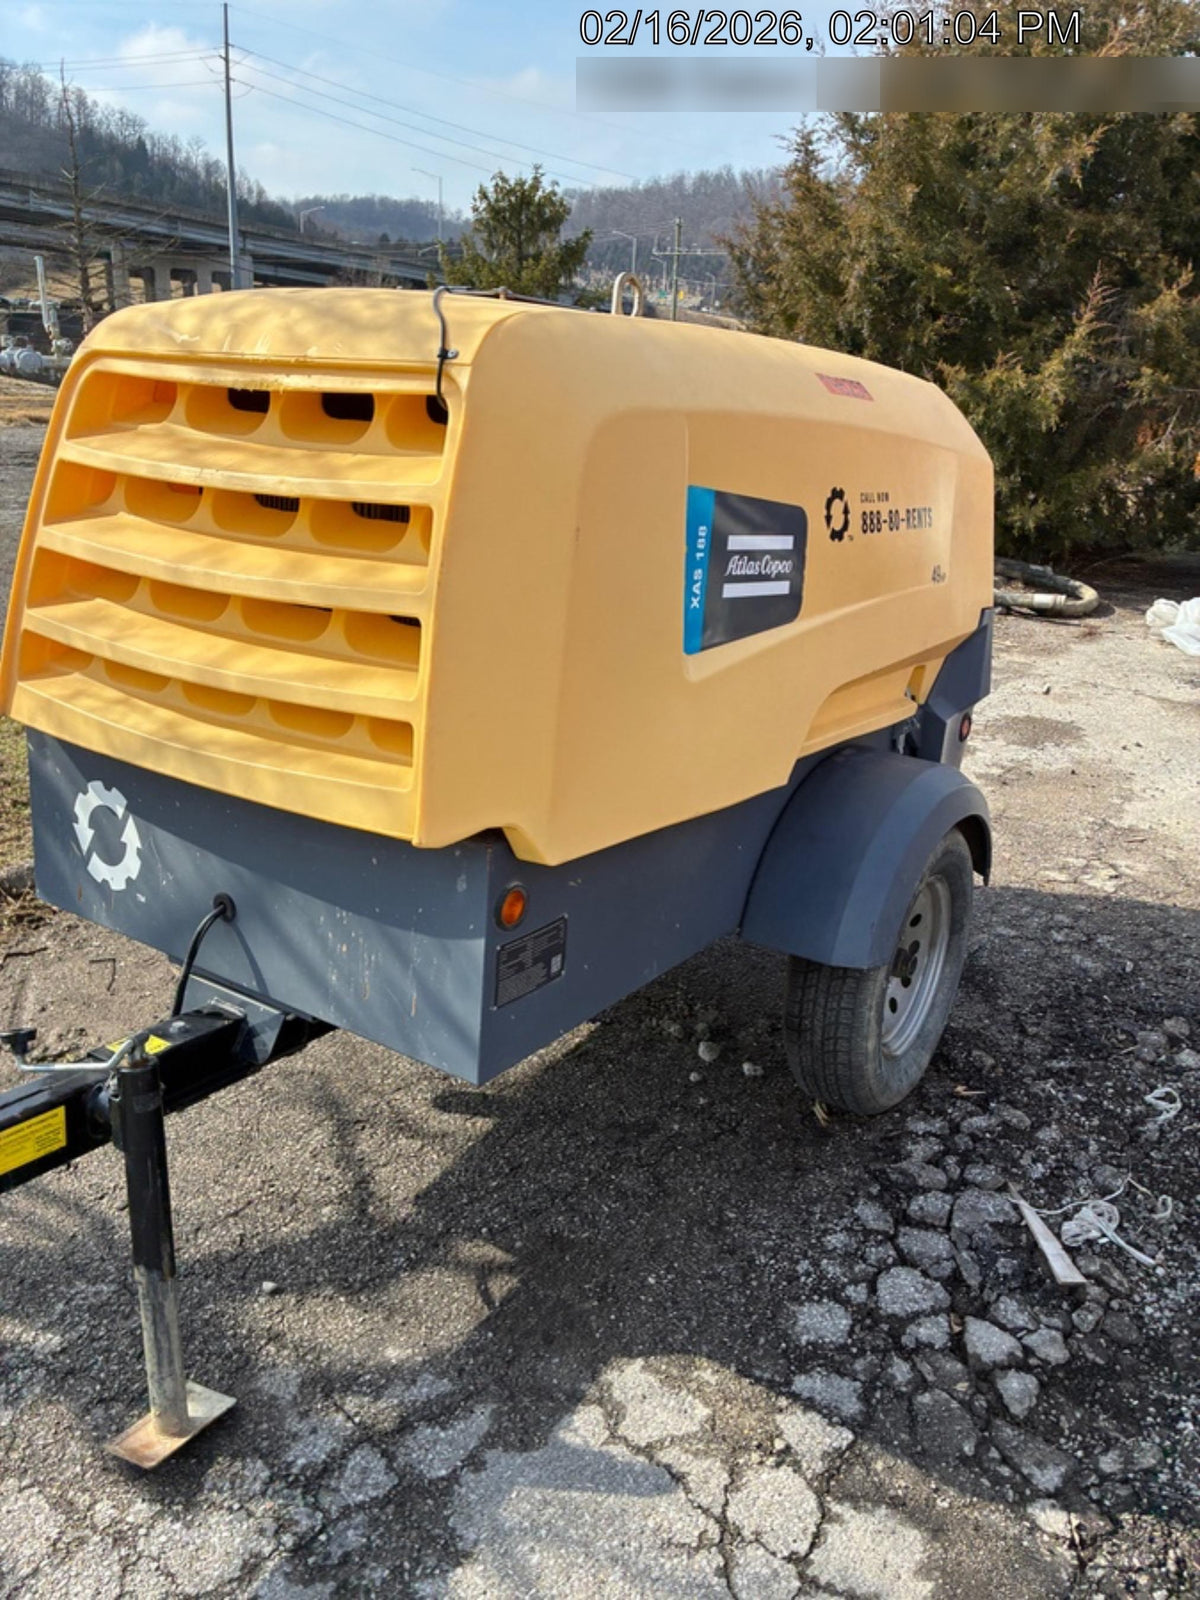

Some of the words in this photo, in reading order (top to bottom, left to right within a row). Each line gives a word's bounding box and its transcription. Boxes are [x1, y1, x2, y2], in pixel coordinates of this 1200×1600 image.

[861, 507, 933, 534] 888-80-RENTS
[696, 525, 708, 561] 188
[724, 555, 760, 577] Atlas
[761, 554, 793, 578] Copco
[690, 568, 703, 609] XAS
